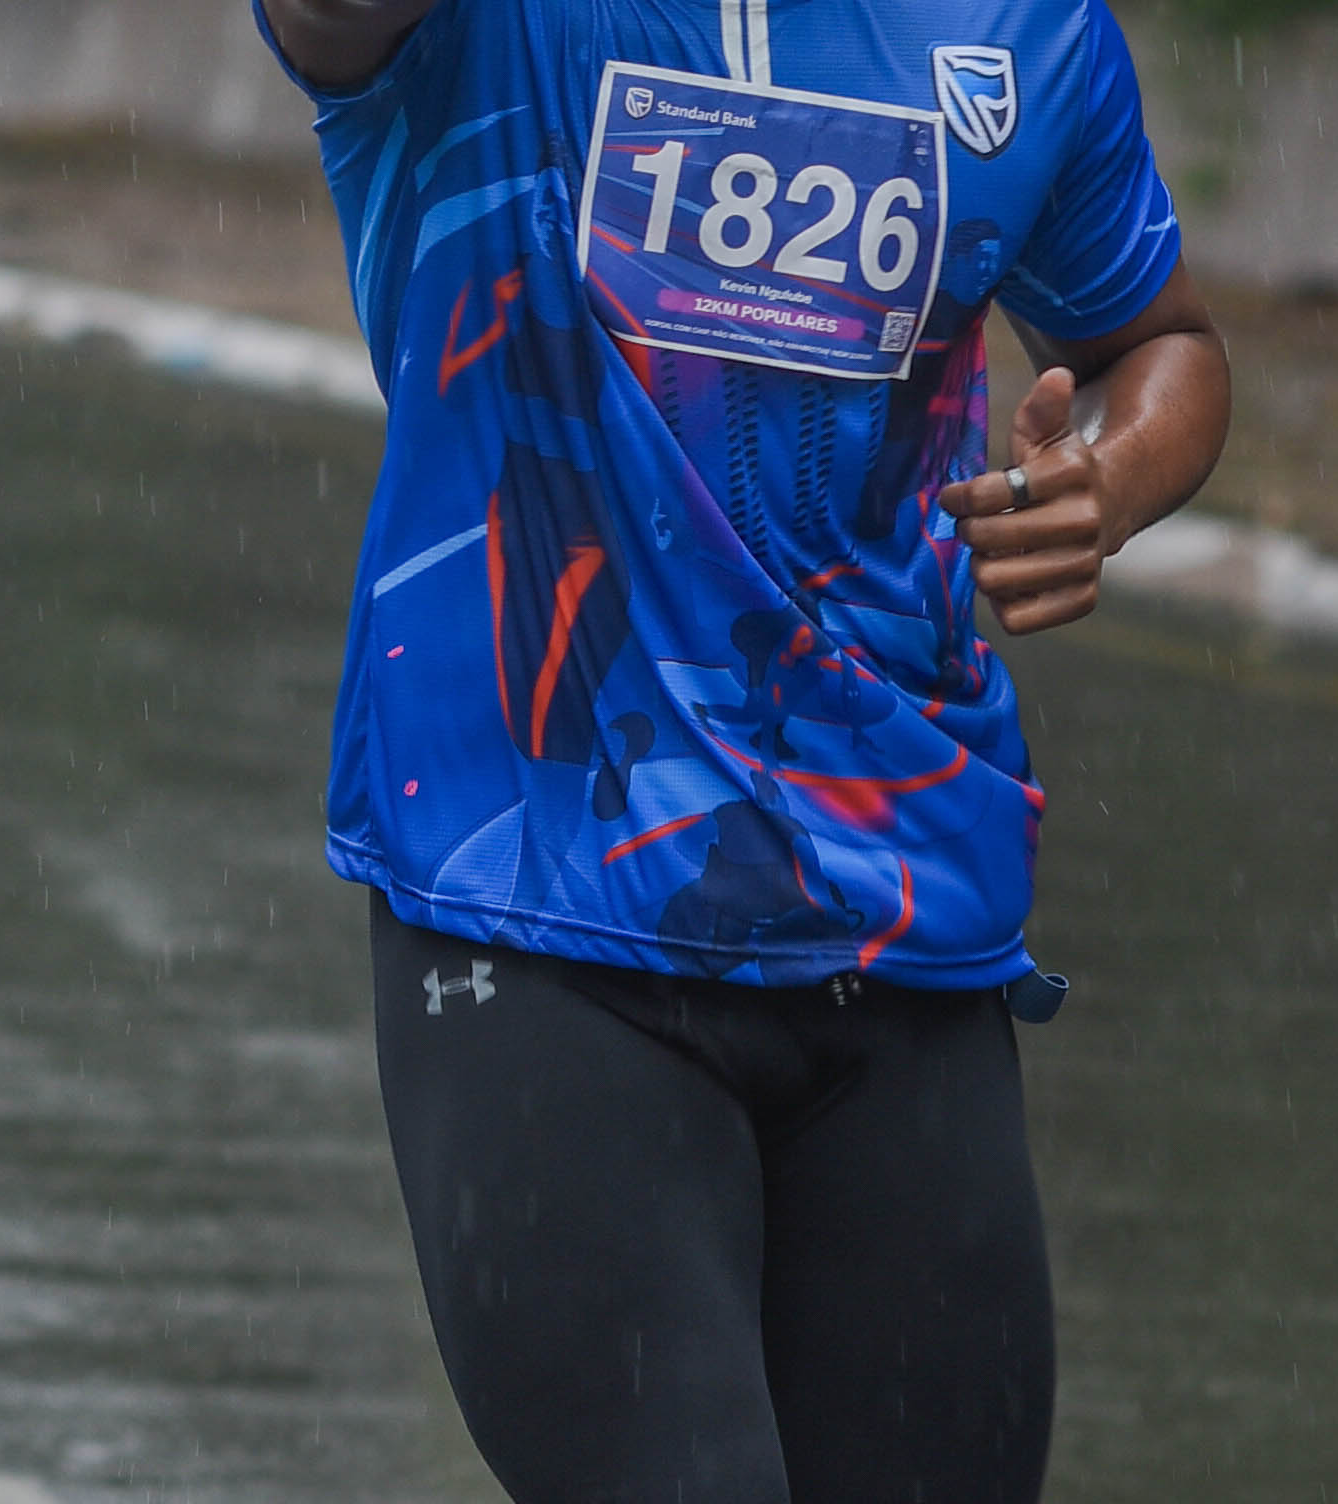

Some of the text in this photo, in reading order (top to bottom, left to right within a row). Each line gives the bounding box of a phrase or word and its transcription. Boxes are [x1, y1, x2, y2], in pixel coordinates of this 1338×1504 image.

[656, 100, 757, 129] Standard Bank
[632, 140, 924, 292] 1826
[720, 279, 757, 295] Kevin
[693, 297, 838, 333] 12KM POPULARES
